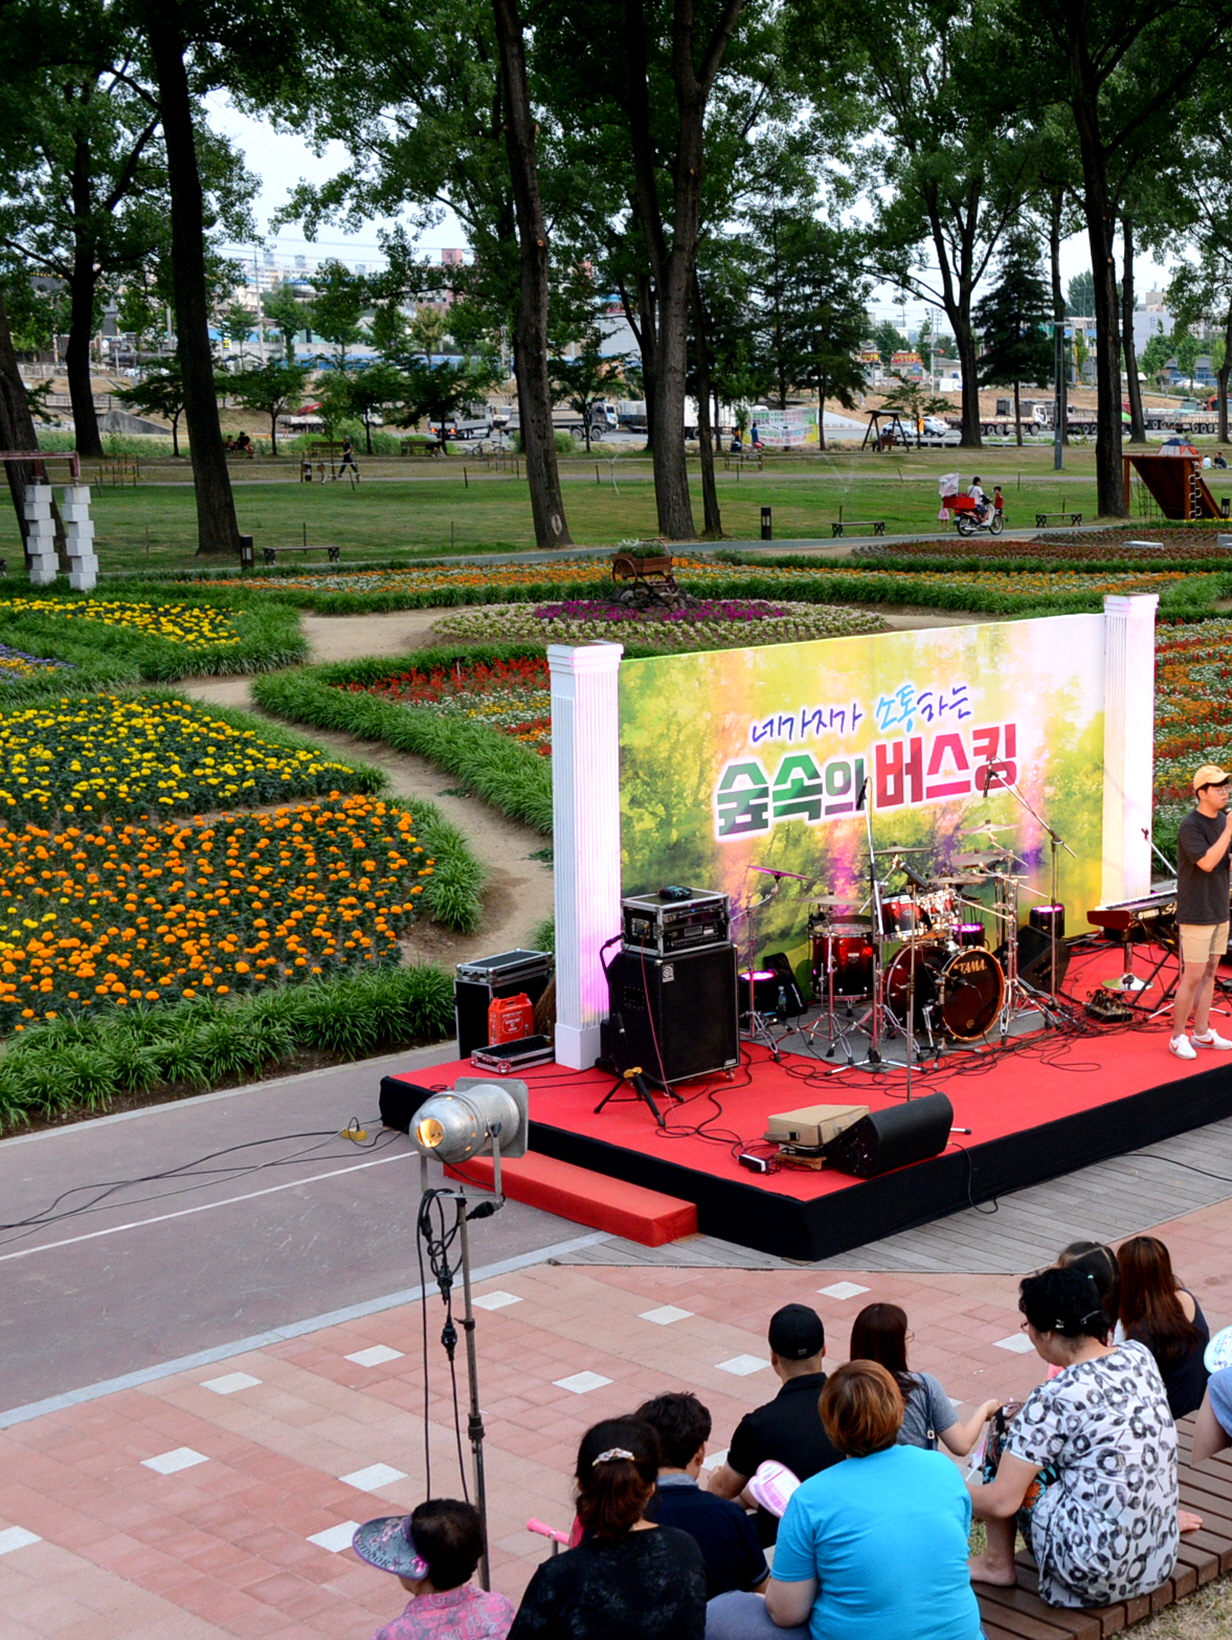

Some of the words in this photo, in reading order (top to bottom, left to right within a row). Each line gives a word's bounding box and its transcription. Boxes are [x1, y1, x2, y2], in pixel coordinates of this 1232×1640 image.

[751, 702, 863, 742] 네가지가
[876, 684, 971, 732] 소통하는
[717, 754, 865, 837] 숲속의
[875, 723, 1017, 809] 버스킹
[954, 959, 987, 974] TAMA
